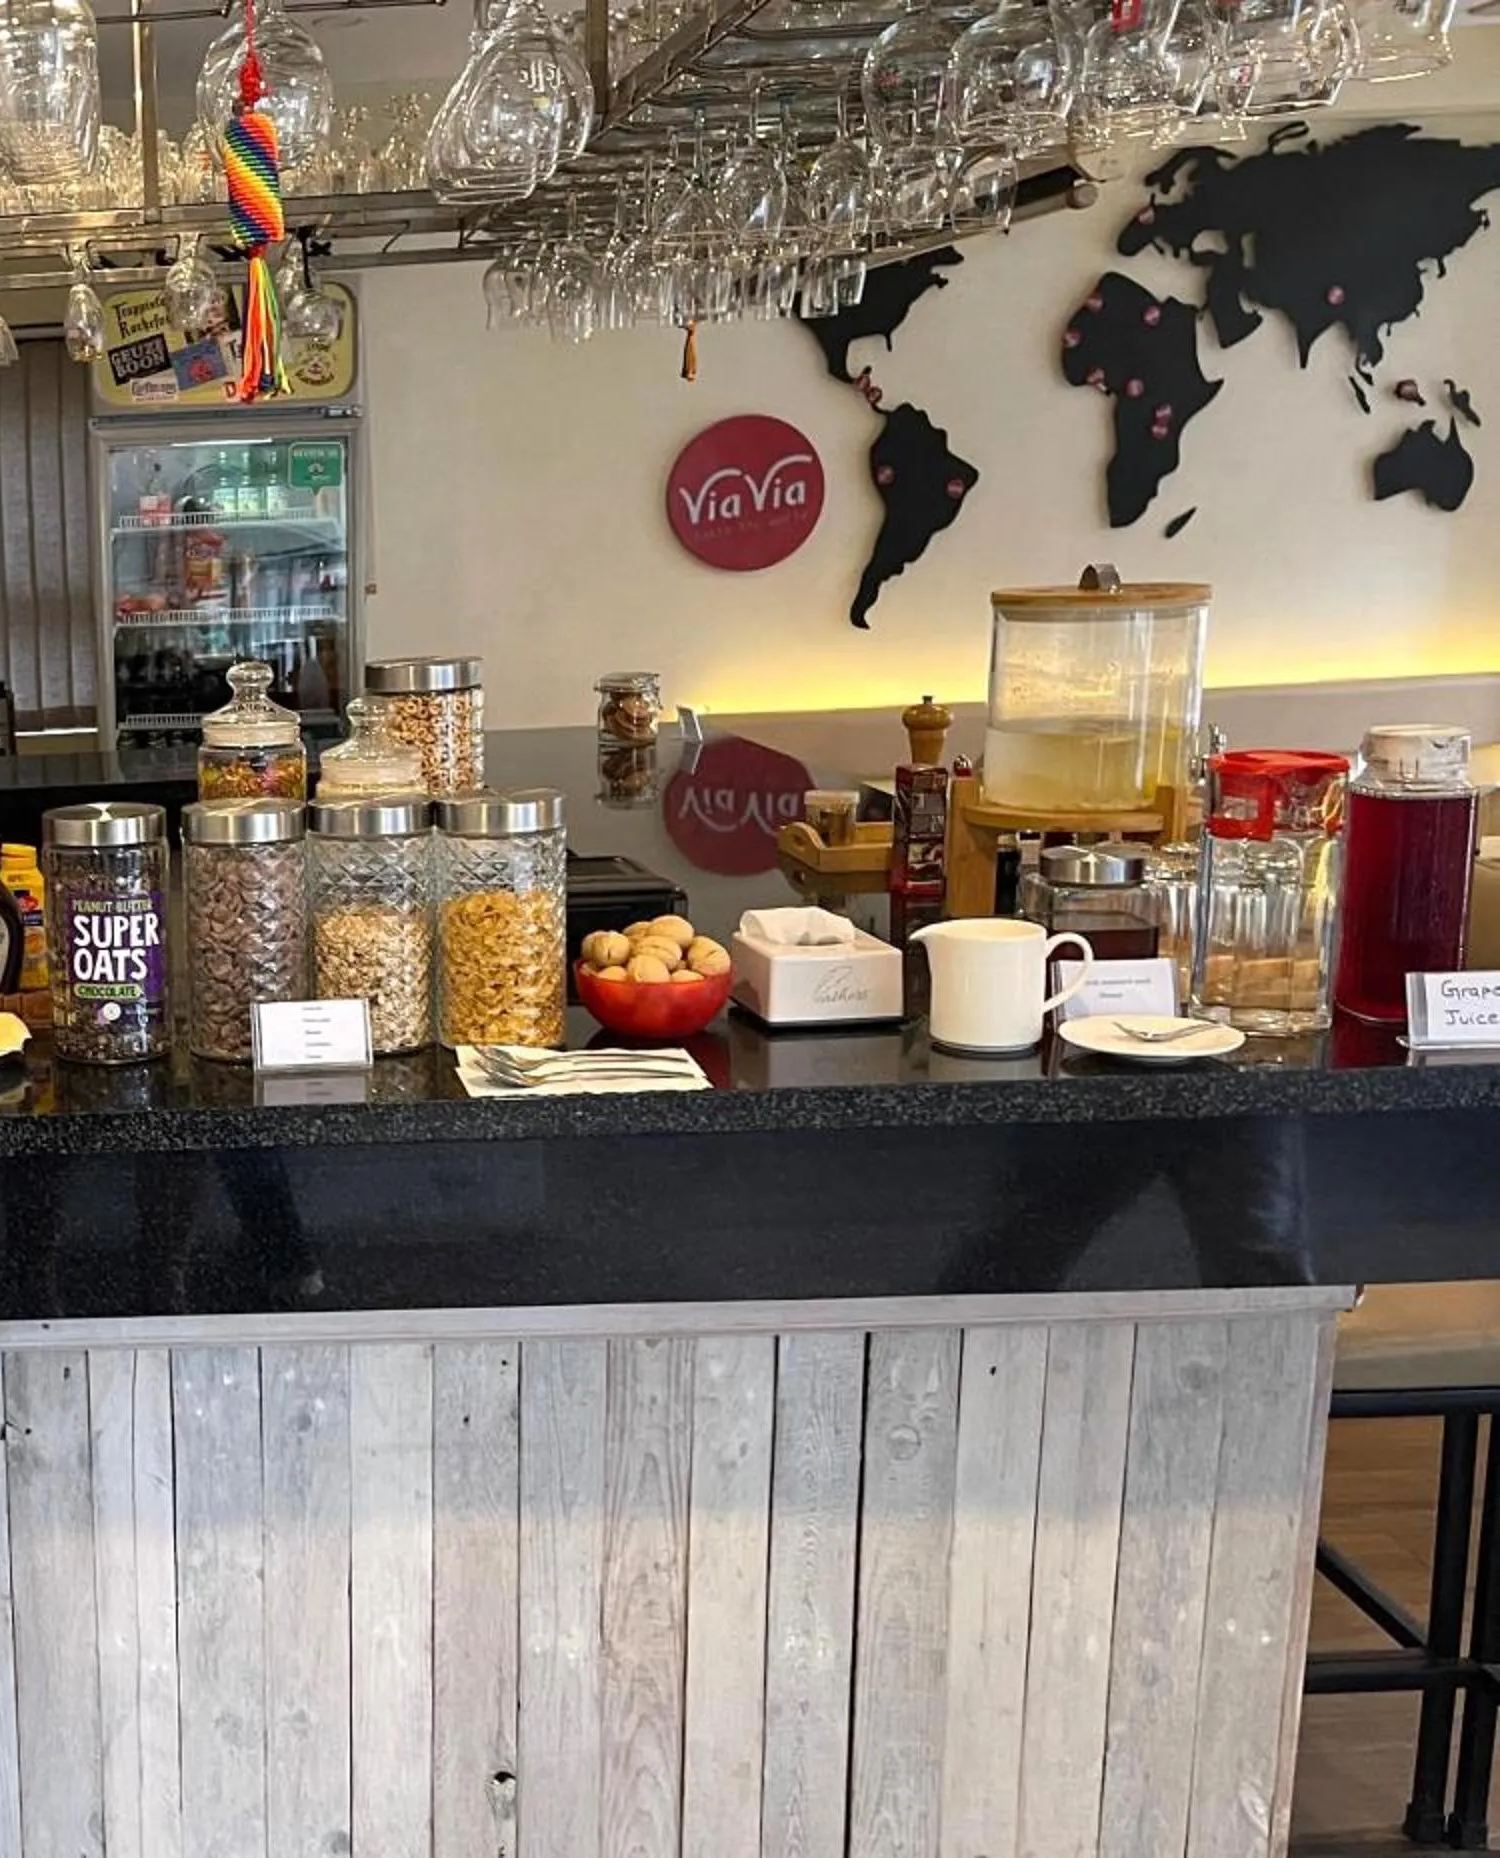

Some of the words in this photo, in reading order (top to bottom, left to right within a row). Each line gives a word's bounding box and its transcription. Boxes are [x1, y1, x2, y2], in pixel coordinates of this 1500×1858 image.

[72, 912, 161, 949] SUPER
[72, 947, 149, 982] OATS
[1443, 1008, 1500, 1026] Juice
